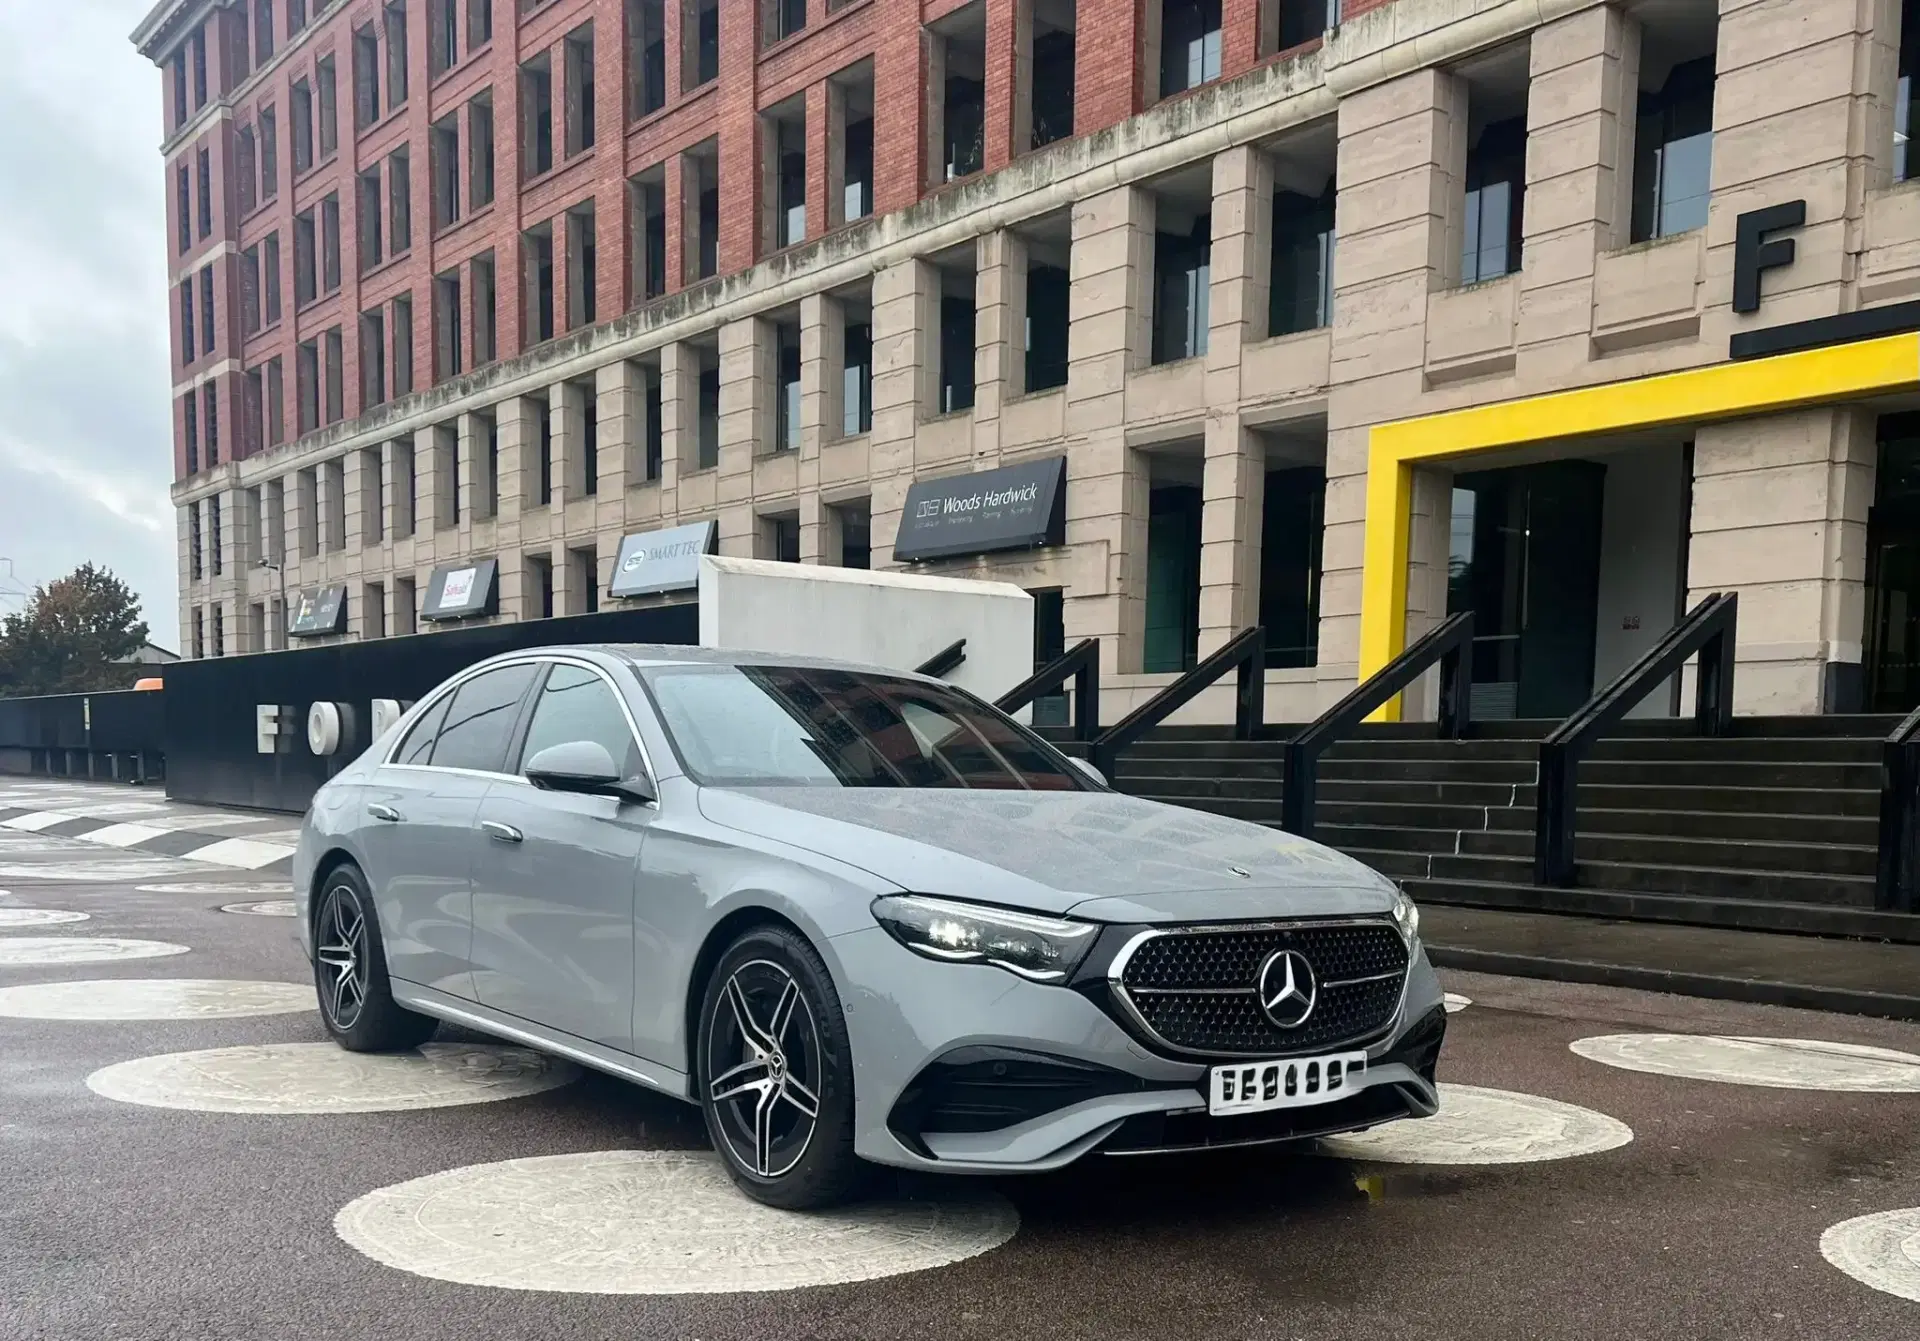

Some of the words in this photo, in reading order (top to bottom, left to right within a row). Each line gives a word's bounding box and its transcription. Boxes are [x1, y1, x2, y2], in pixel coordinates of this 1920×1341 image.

[1732, 199, 1806, 314] F
[943, 492, 981, 514] Woods
[983, 482, 1037, 508] Hardwick
[649, 543, 680, 560] SMART
